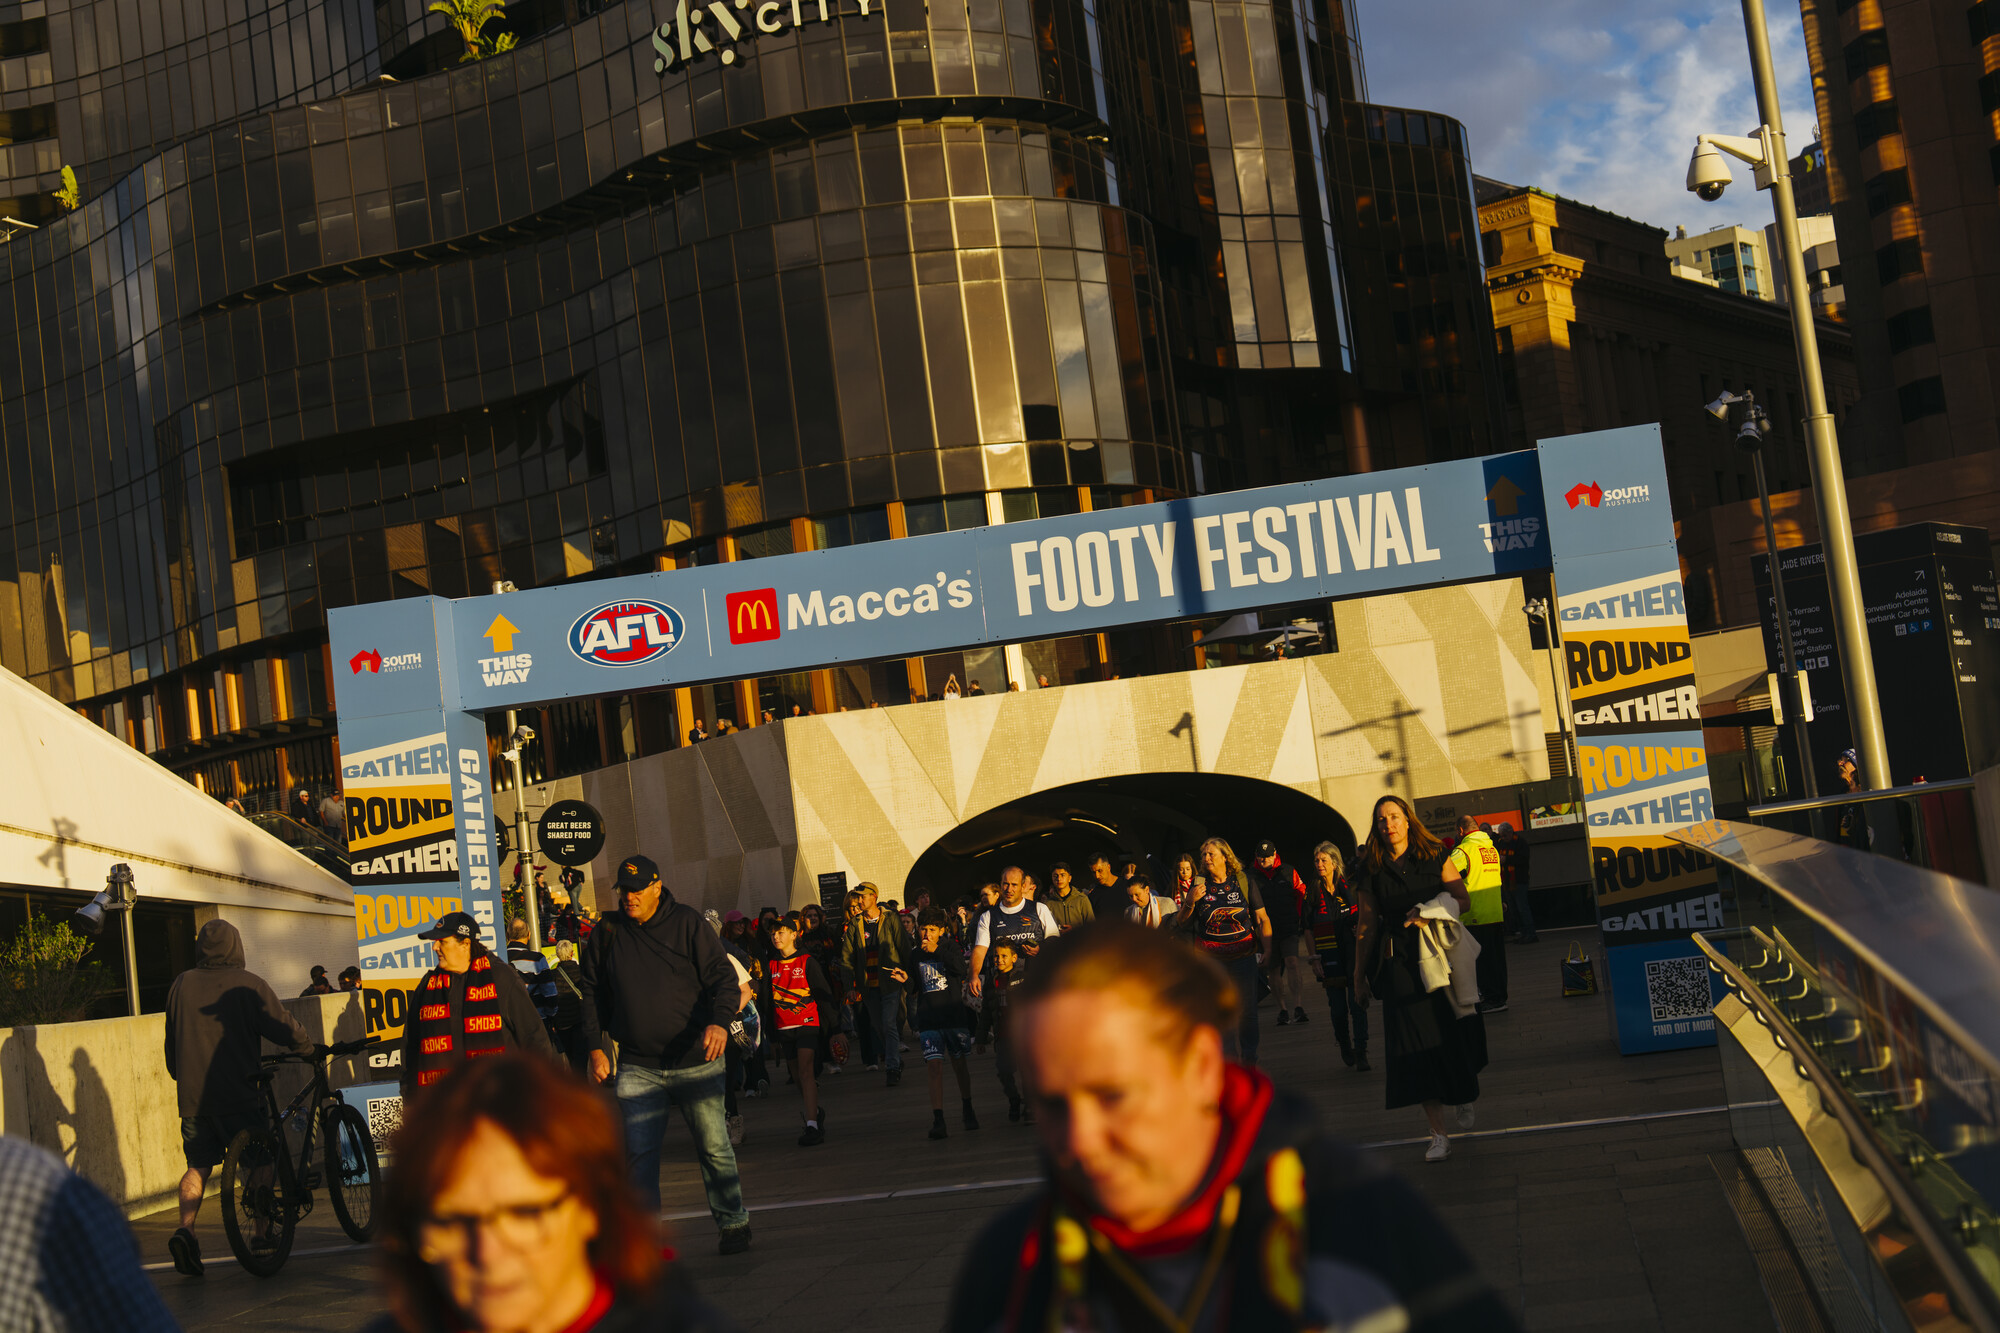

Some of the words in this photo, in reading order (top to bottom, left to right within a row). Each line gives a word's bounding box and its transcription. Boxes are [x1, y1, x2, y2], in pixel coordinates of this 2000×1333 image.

[1604, 485, 1650, 501] SOUTH
[1605, 496, 1651, 507] AUSTRALIA
[1478, 517, 1541, 538] THIS
[1483, 532, 1538, 553] WAY
[1011, 521, 1178, 617] FOOTY
[1198, 487, 1441, 592] FESTIVAL
[1765, 557, 1799, 573] AAIDE
[786, 571, 973, 630] Macca's
[1560, 581, 1685, 621] GATHER
[1794, 606, 1820, 617] Terrace
[1866, 612, 1896, 624] verbank
[1897, 611, 1911, 619] Car
[1913, 607, 1931, 616] Park
[1904, 597, 1929, 607] Centre
[580, 611, 677, 653] AFL
[383, 653, 422, 668] SOUTH
[384, 663, 423, 673] AUSTRALIA
[478, 654, 533, 673] THIS
[1564, 640, 1692, 690] ROUND
[481, 668, 531, 687] WAY
[1574, 685, 1700, 725] GATHER
[342, 743, 449, 780] GATHER
[1578, 745, 1707, 795] ROUND
[346, 796, 453, 843] ROUND
[458, 748, 491, 892] GATHER
[1588, 787, 1714, 827] GATHER
[547, 831, 573, 839] SHARED
[574, 831, 592, 839] FOOD
[350, 839, 459, 876] GATHER
[1592, 846, 1716, 896] ROUND
[354, 894, 462, 940] ROUND
[1602, 893, 1725, 932] GATHER
[360, 941, 438, 970] GATH
[1653, 1023, 1673, 1036] FIND
[1674, 1021, 1691, 1034] OUT
[1693, 1019, 1716, 1032] MORE
